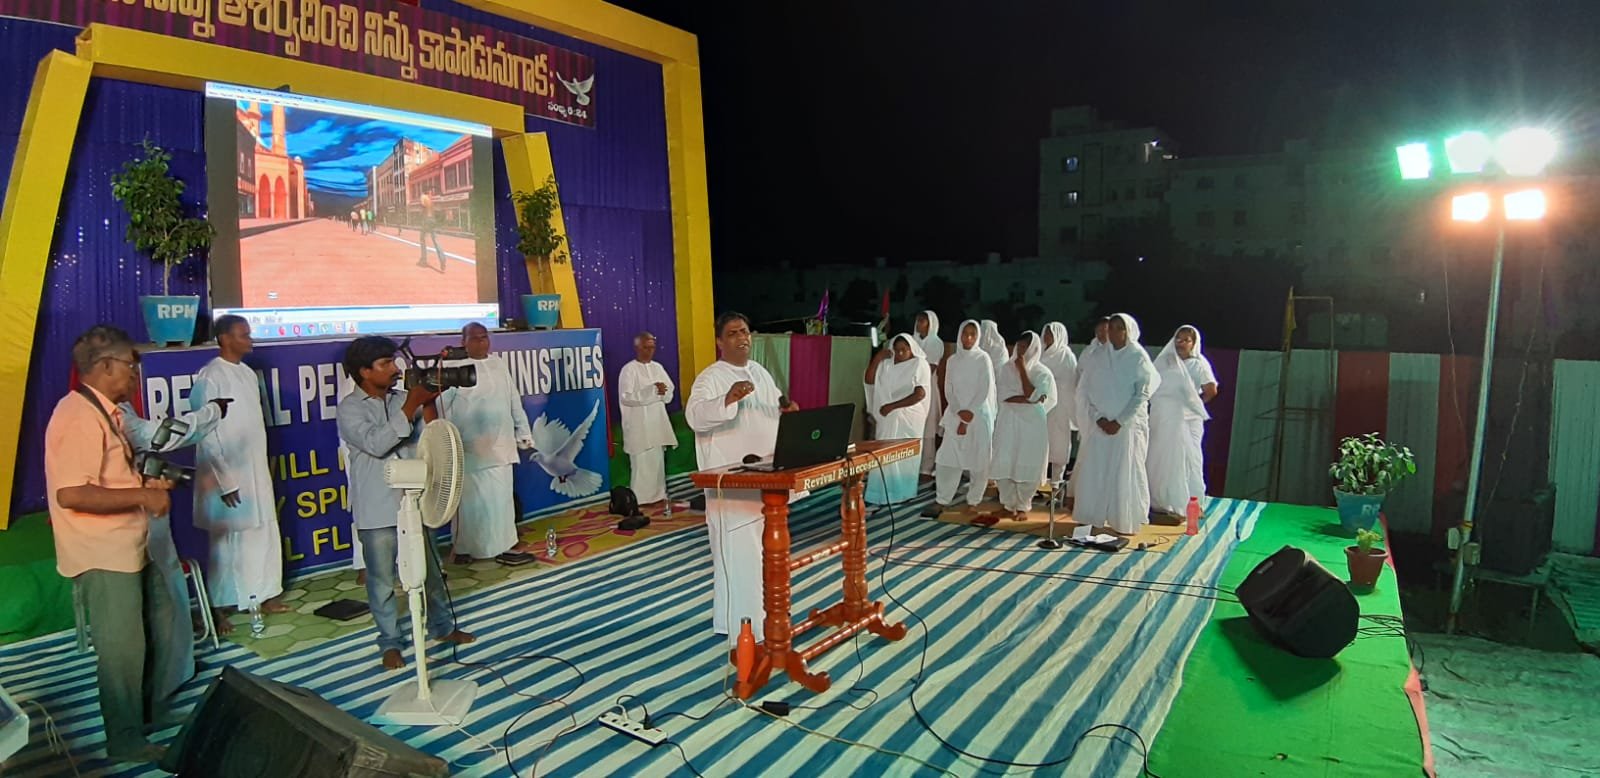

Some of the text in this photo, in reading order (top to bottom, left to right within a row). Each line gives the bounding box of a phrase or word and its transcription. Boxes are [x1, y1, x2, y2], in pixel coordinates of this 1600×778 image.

[364, 10, 418, 80] నిన్ను
[271, 449, 329, 480] ILL
[803, 469, 836, 489] Revival
